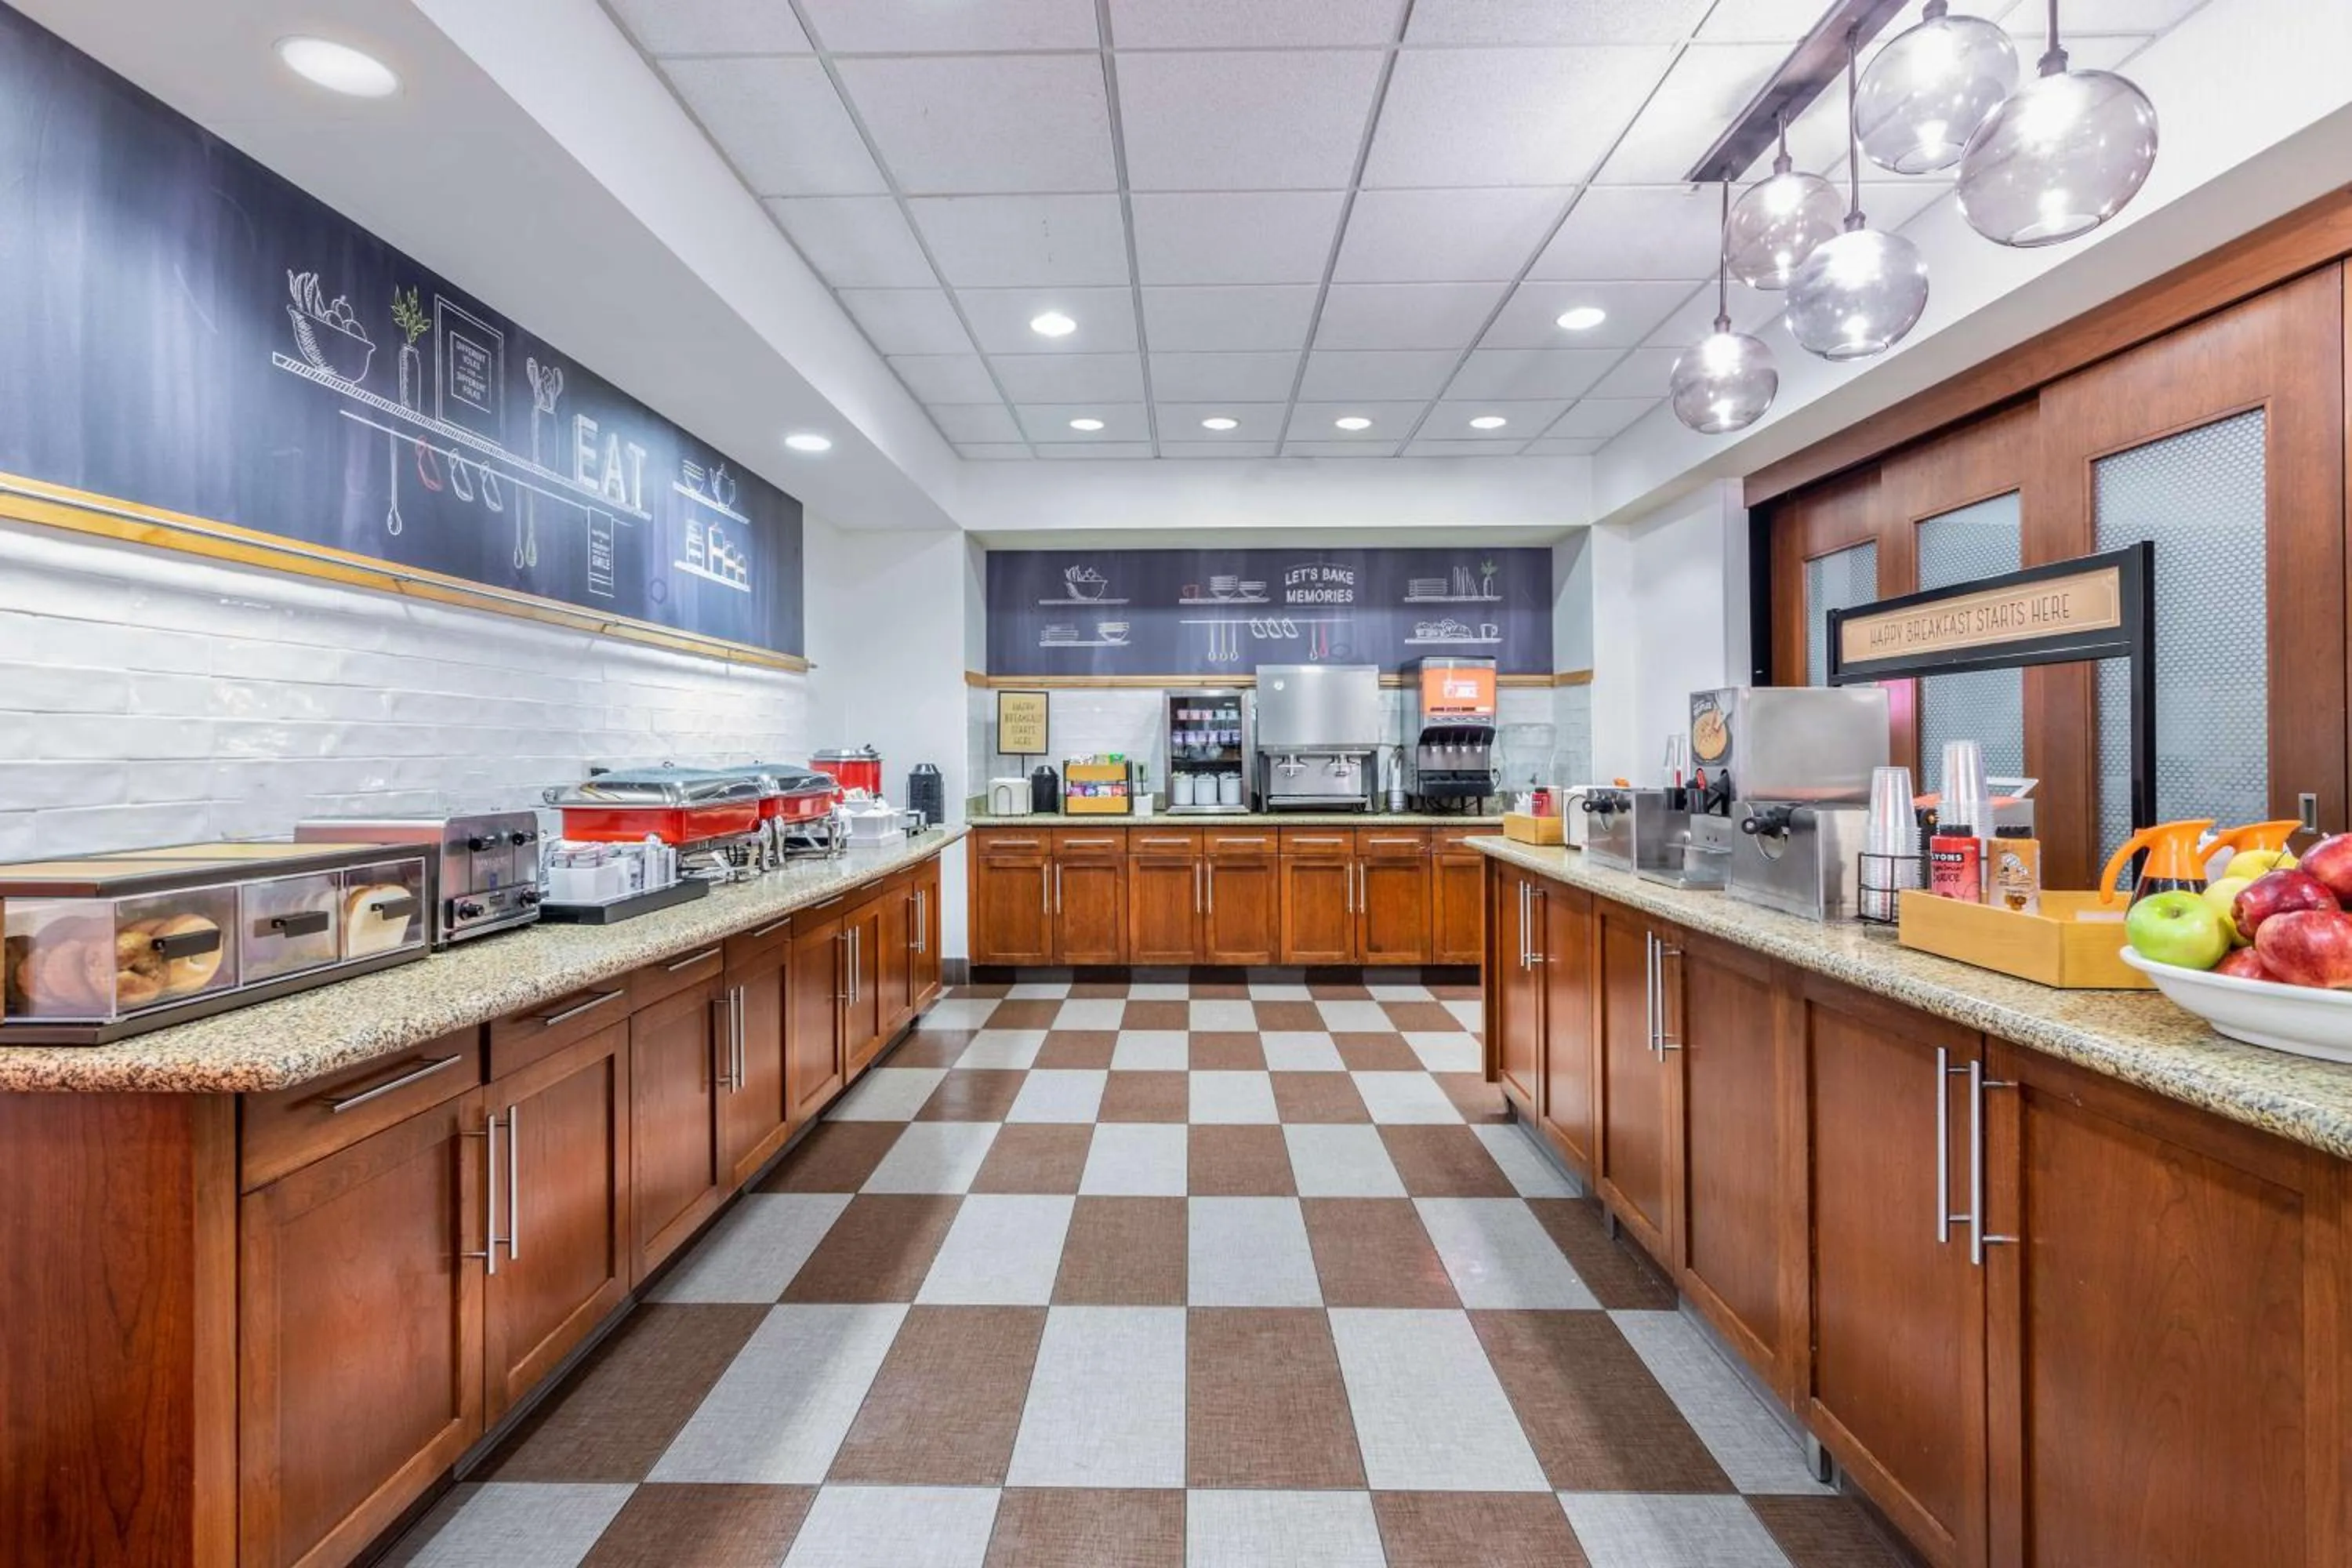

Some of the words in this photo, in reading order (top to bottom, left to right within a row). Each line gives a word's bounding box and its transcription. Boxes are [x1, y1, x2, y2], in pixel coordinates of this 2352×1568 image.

[572, 413, 647, 510] EAT
[1285, 568, 1318, 586] LET'S
[1323, 568, 1354, 586] BAKE
[1287, 590, 1354, 603] MEMORIES
[1869, 625, 1903, 648] HAPPY
[1907, 611, 1972, 643] BREAKFAST
[1976, 601, 2026, 632] STARTS
[2031, 593, 2071, 623] HERE
